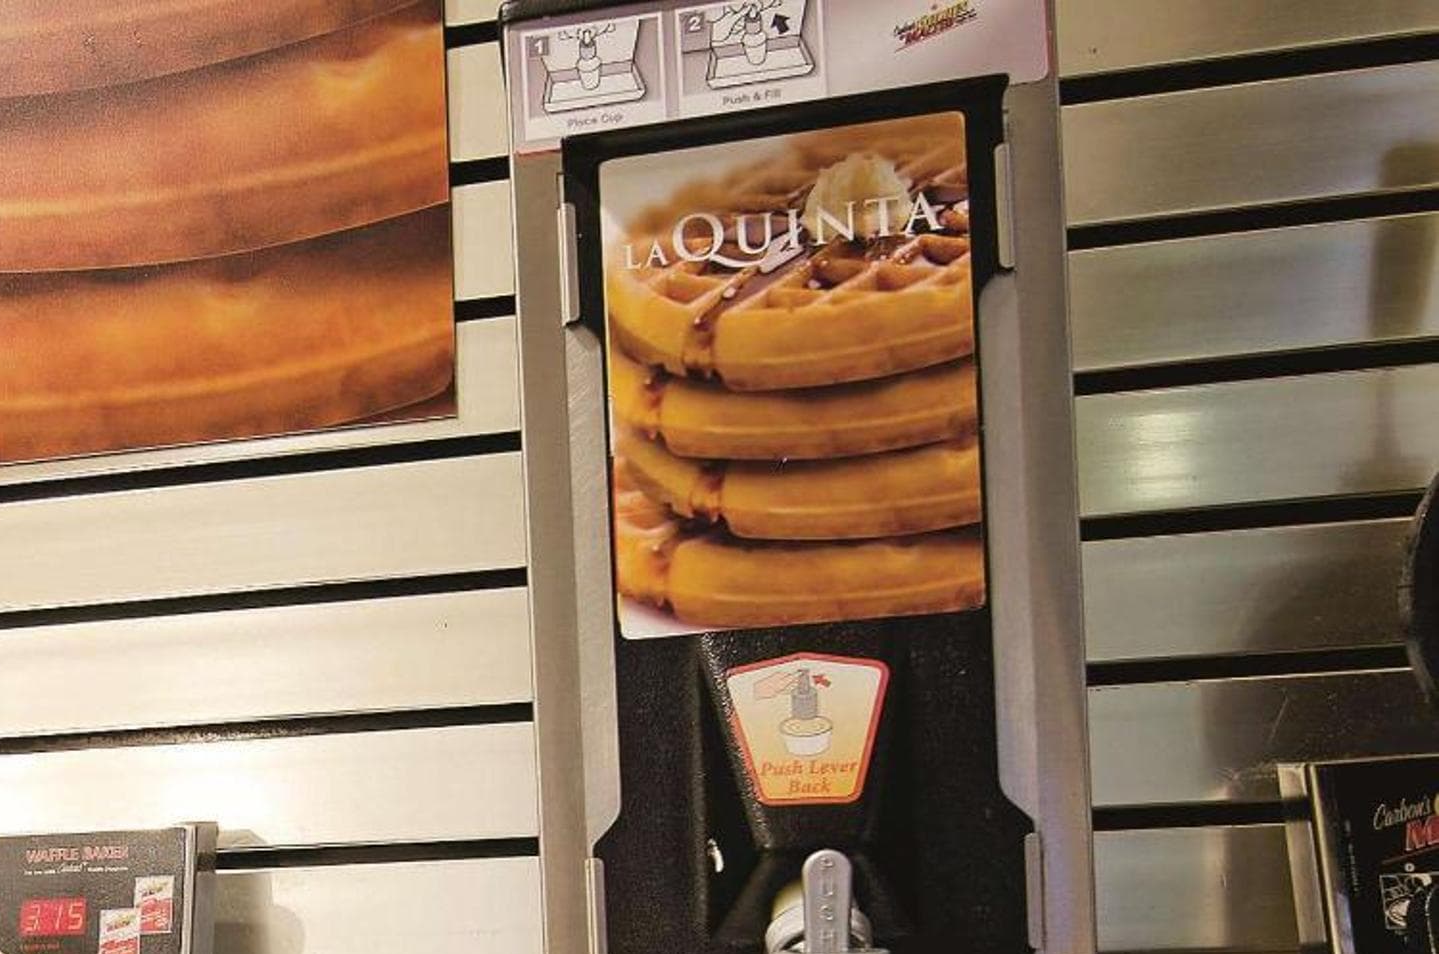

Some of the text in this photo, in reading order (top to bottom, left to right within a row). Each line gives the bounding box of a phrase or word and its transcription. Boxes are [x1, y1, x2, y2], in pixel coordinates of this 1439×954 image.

[688, 16, 702, 32] 2
[534, 39, 544, 54] 1
[722, 95, 750, 106] Push
[765, 88, 782, 100] Fill
[566, 112, 623, 128] Place Cup
[623, 191, 946, 271] LA QUINTA
[760, 759, 858, 776] Push Lever
[789, 776, 832, 794] Back
[1373, 796, 1431, 831] Carbon's
[26, 845, 129, 864] WAFFLE BAKER
